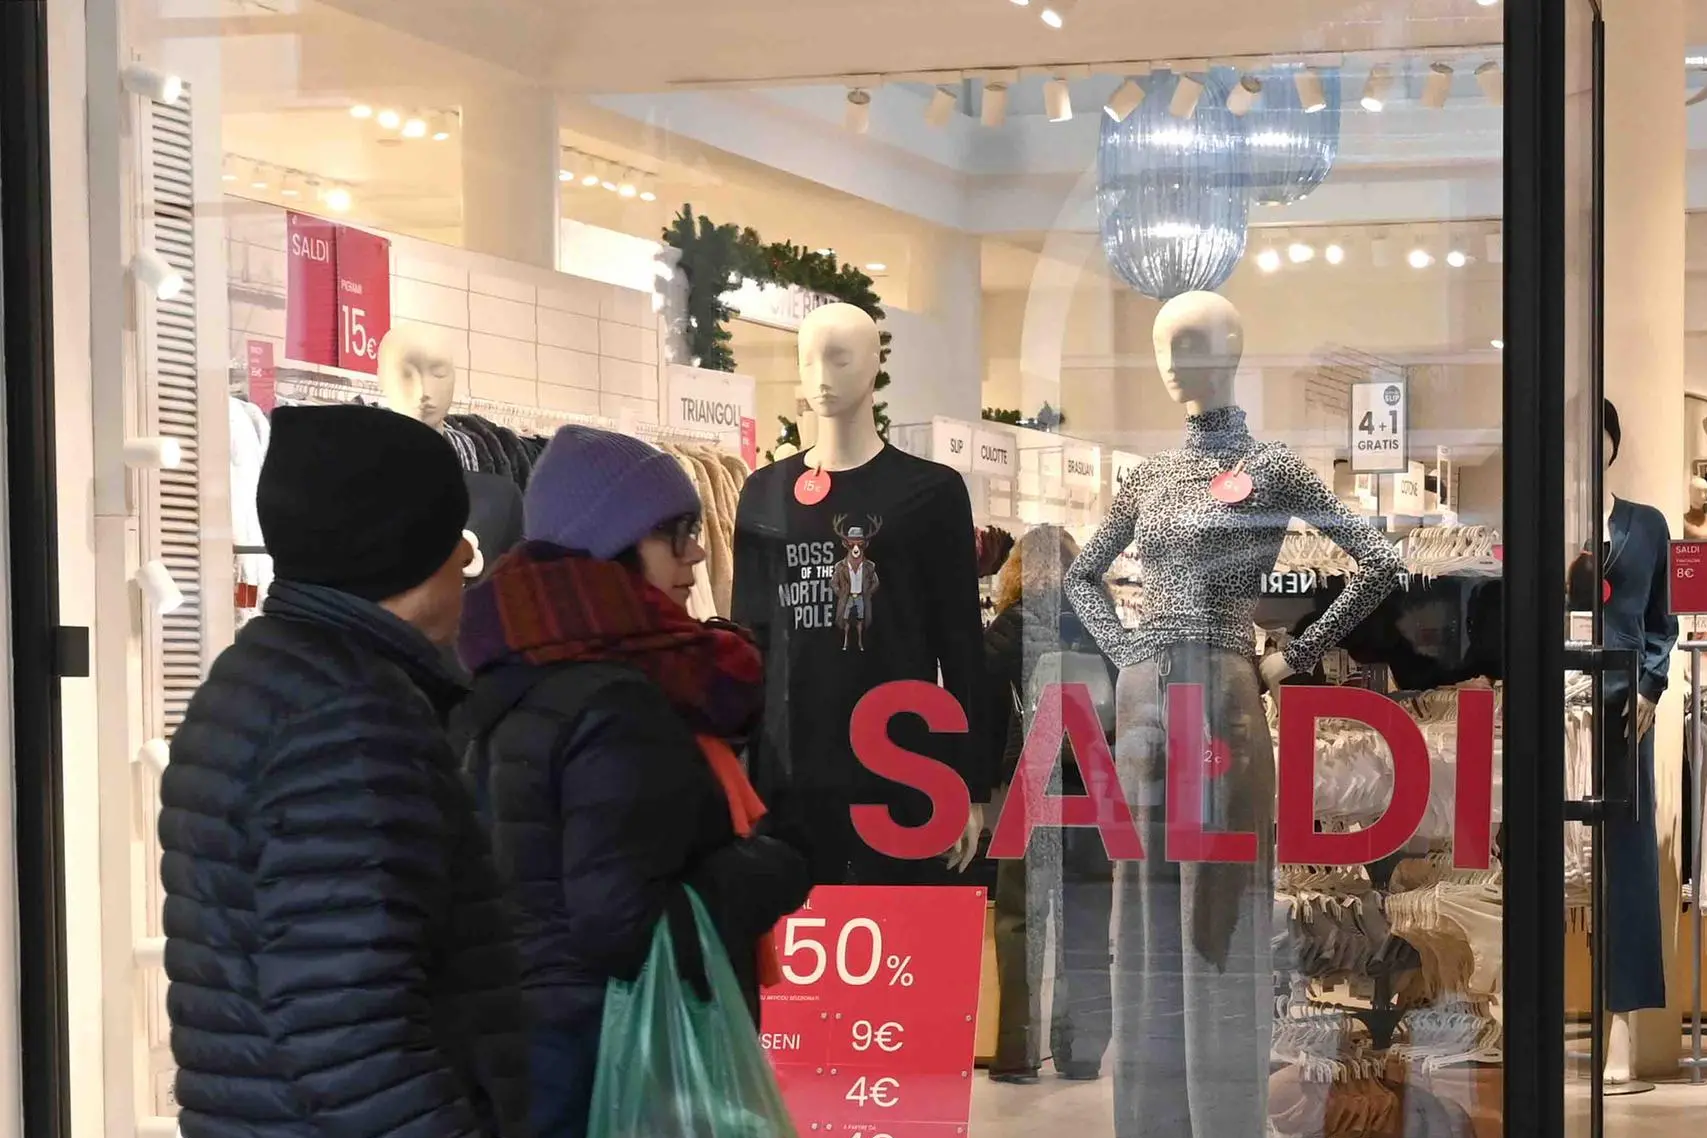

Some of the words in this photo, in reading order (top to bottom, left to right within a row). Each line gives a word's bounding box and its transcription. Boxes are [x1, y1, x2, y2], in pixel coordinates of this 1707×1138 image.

[291, 233, 330, 263] SALDI
[342, 305, 377, 359] 15€
[950, 438, 964, 454] SLIP
[981, 445, 1008, 464] CULOTTE
[1358, 439, 1399, 450] GRATIS
[786, 541, 834, 567] BOSS
[1675, 545, 1700, 554] SALDI
[801, 566, 812, 579] OF
[816, 565, 834, 578] THE
[1676, 567, 1695, 578] 8€
[778, 580, 834, 607] NORTH
[794, 604, 834, 630] POLE
[849, 679, 1495, 870] SALDI
[781, 917, 914, 986] 50%
[852, 1020, 904, 1052] 9€
[845, 1076, 900, 1108] 4€
